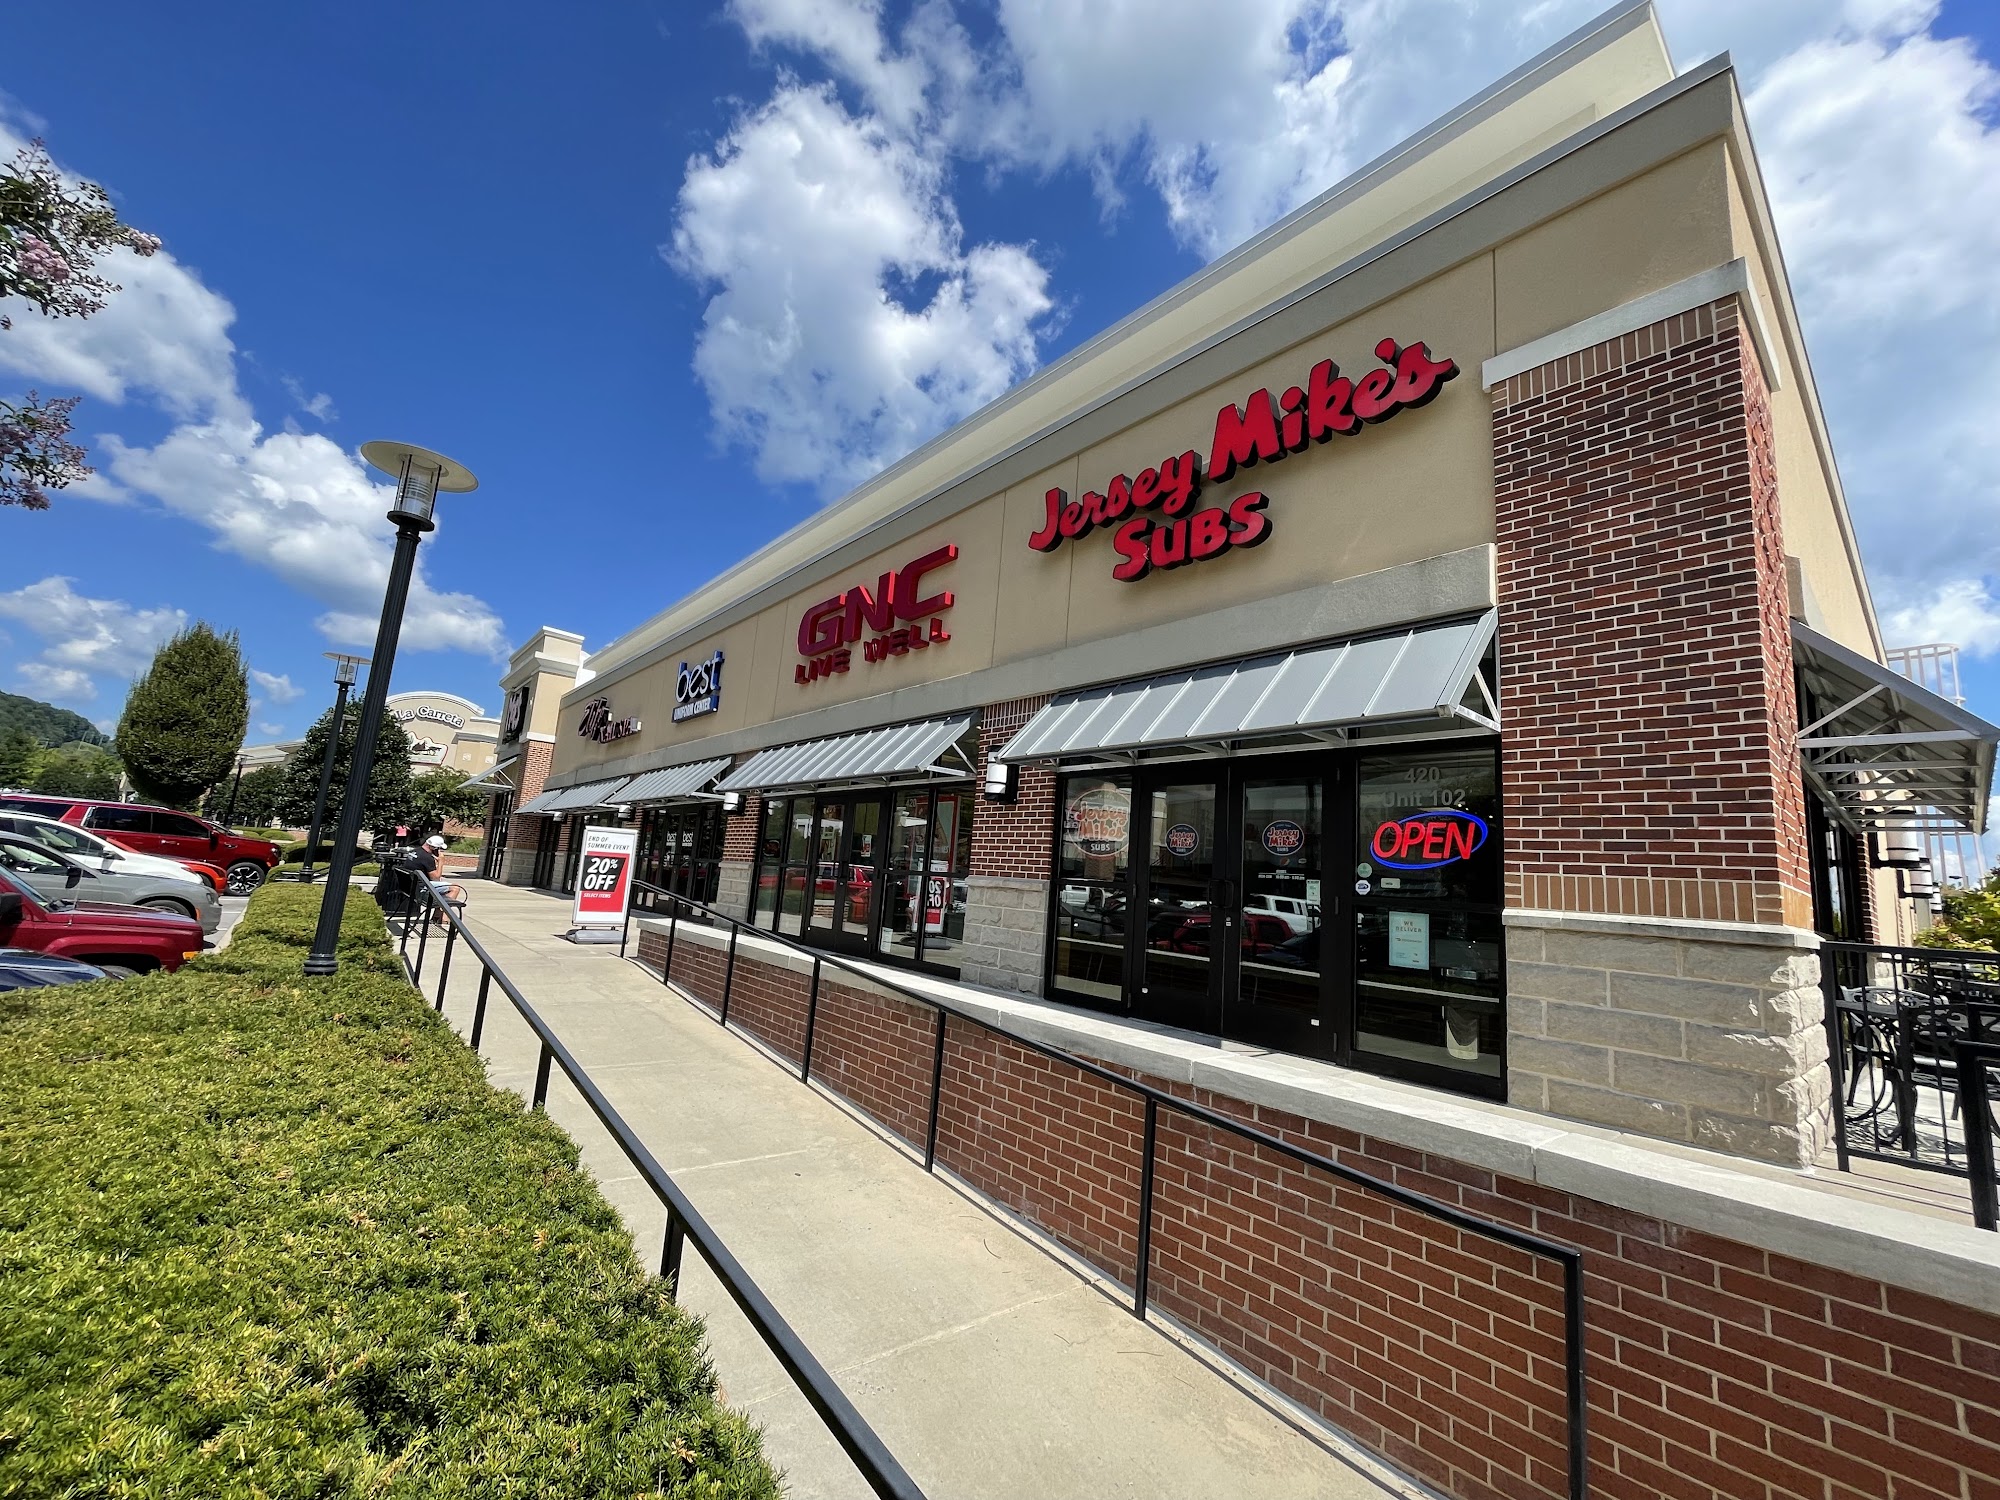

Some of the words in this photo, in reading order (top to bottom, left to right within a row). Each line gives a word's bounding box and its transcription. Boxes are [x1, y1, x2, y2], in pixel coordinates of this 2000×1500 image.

[1028, 450, 1204, 552] Jersey
[1208, 337, 1460, 484] Mike's
[1112, 491, 1273, 583] SUBS
[798, 544, 959, 656] GNC
[795, 649, 851, 684] LIVE
[864, 617, 951, 663] WELL
[676, 650, 724, 702] best
[694, 697, 711, 714] CENTER
[395, 709, 415, 721] La
[416, 705, 464, 729] Carreta
[1405, 766, 1441, 783] 420
[1382, 790, 1422, 807] Unit
[1430, 789, 1466, 806] 102
[1075, 801, 1128, 827] Jersey
[1169, 830, 1195, 842] Jersey
[1266, 826, 1299, 841] Jersey
[1373, 821, 1476, 859] OPEN
[1090, 843, 1111, 851] SUBS
[587, 857, 618, 874] 20%
[584, 874, 616, 890] OFF
